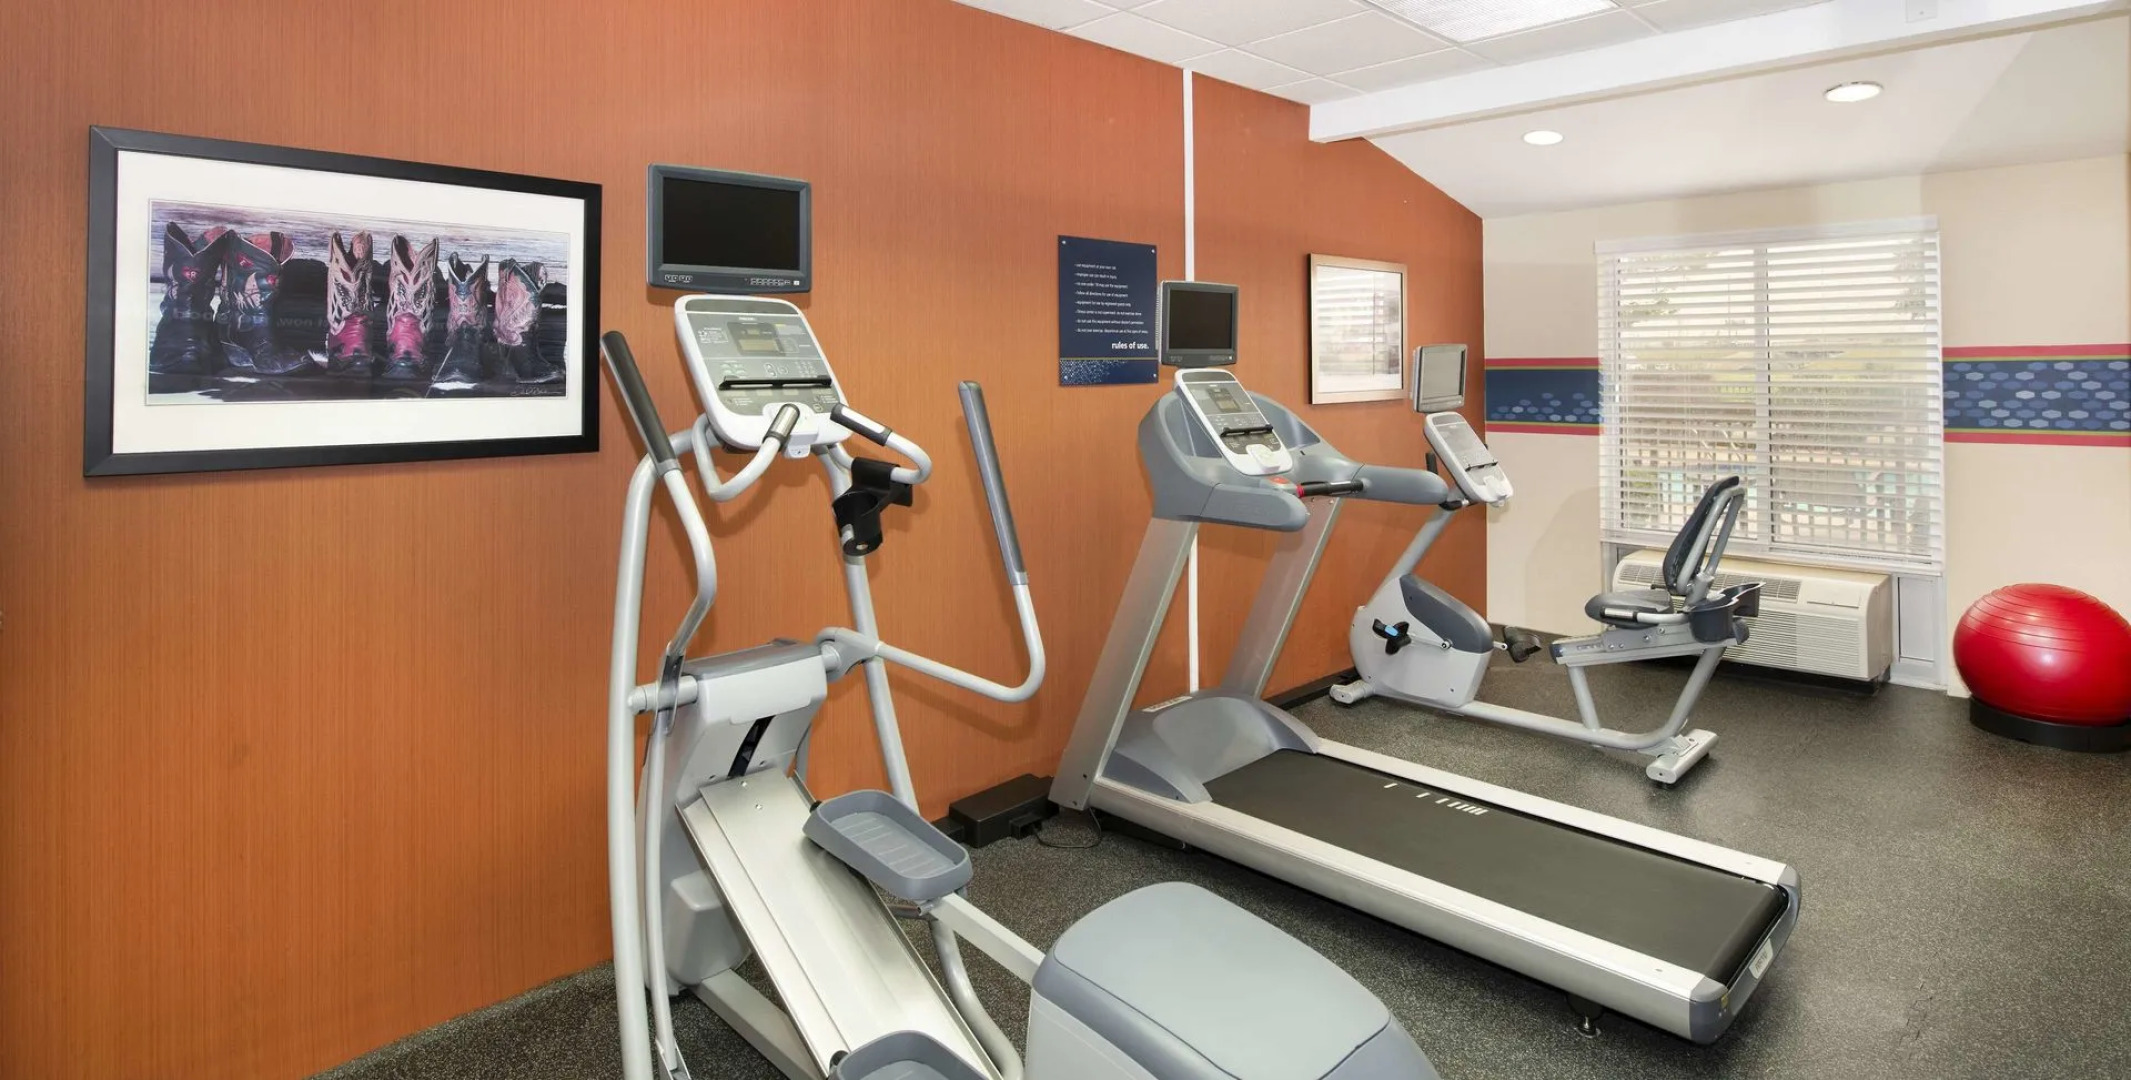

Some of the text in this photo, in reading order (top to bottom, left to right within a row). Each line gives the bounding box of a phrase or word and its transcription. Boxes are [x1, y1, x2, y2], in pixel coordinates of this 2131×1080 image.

[1111, 341, 1150, 350] rules of use.
